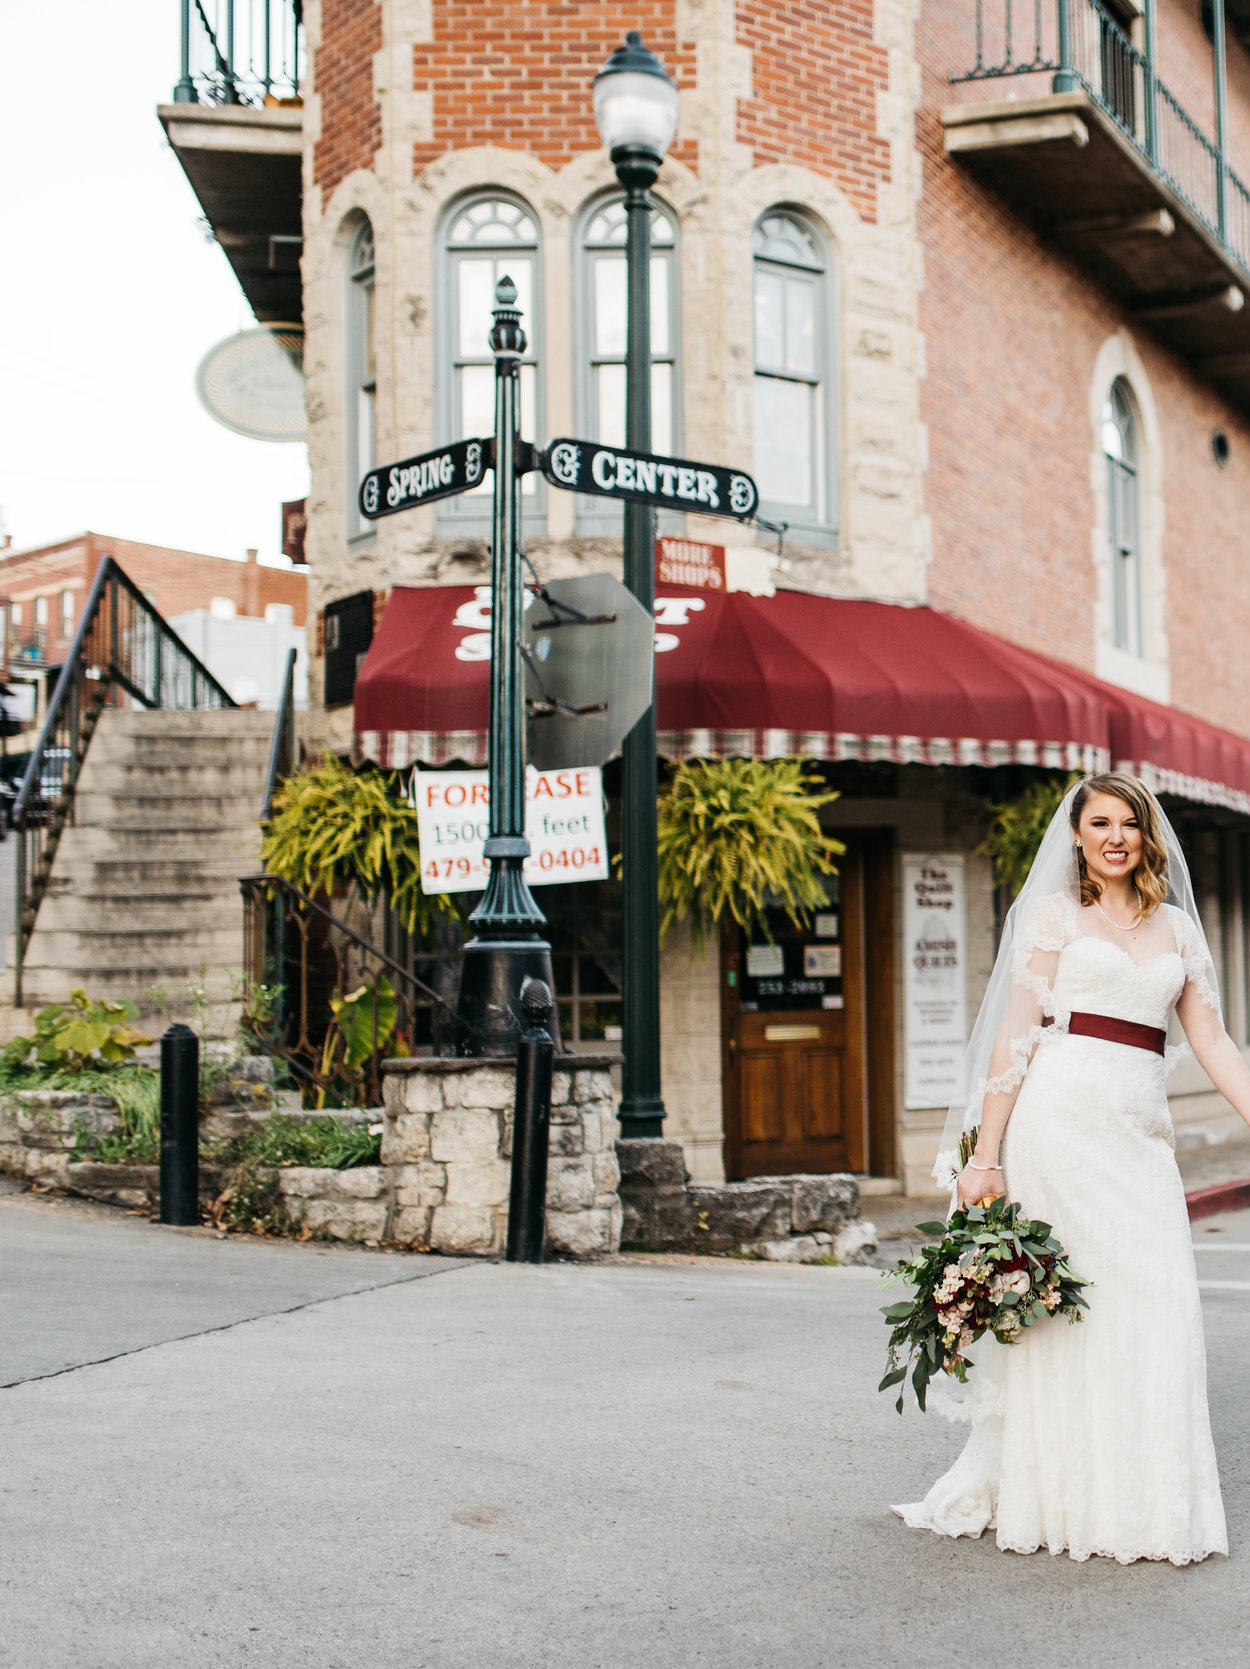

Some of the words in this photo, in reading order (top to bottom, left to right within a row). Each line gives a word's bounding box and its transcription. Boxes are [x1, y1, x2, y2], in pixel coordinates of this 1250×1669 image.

[592, 451, 720, 508] CENTER
[661, 539, 714, 566] MORE
[659, 560, 722, 588] SHOPS
[427, 783, 489, 808] FOR
[542, 814, 591, 837] feet
